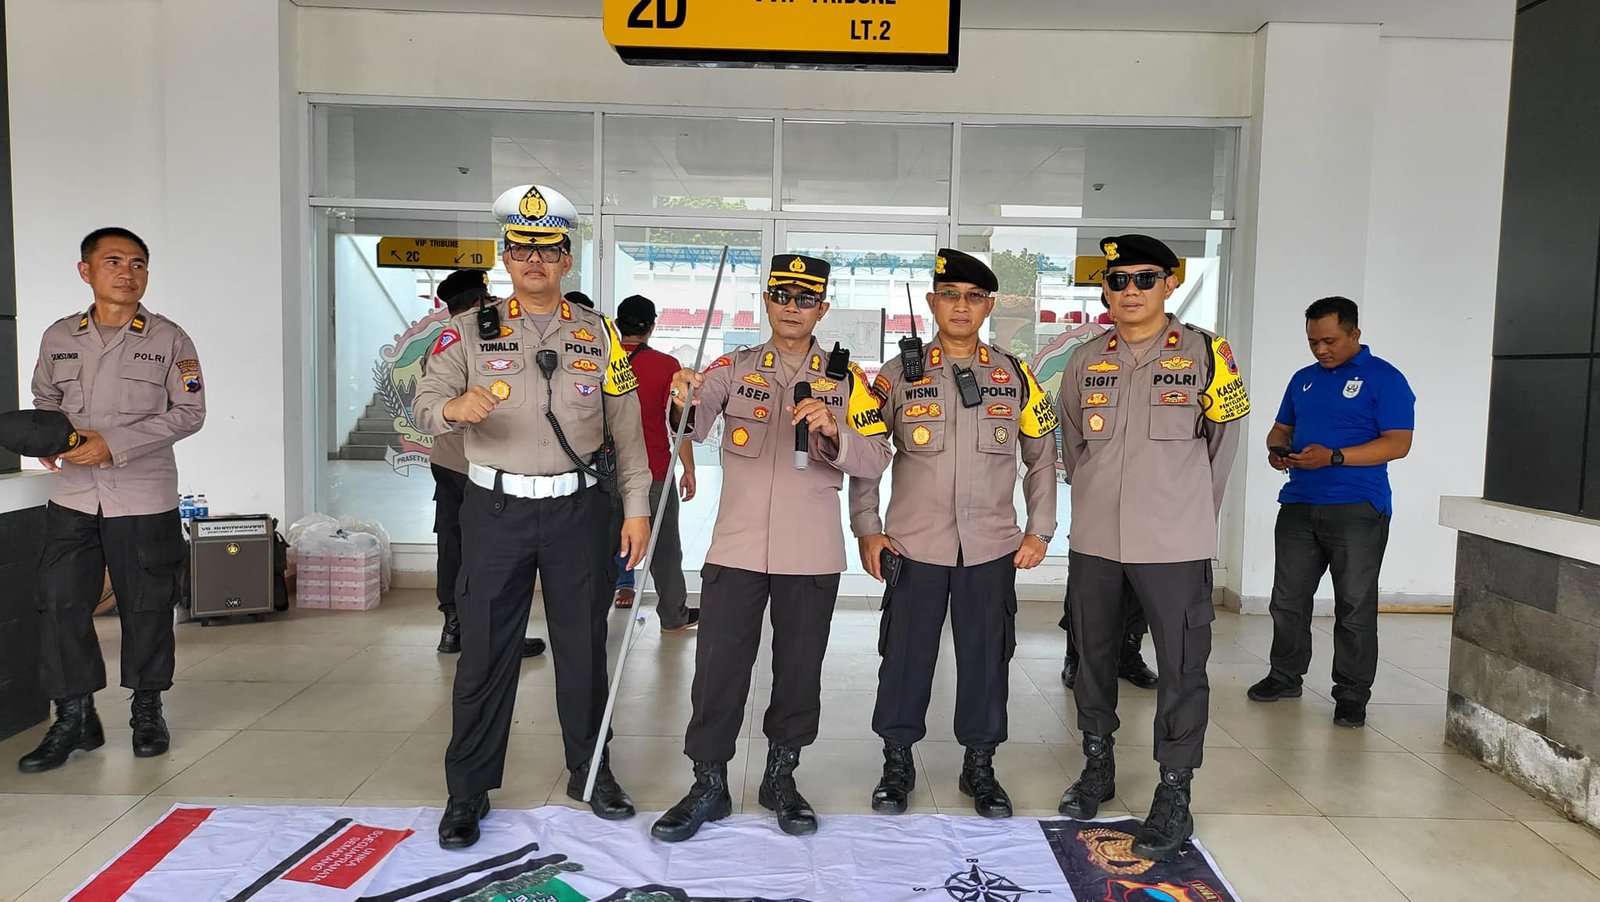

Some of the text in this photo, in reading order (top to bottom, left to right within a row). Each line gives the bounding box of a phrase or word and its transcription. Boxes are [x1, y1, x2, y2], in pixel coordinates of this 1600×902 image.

[850, 19, 892, 41] LT.2
[415, 239, 459, 248] VIP TRIBUNE
[406, 251, 420, 262] 2C
[470, 253, 483, 264] 1D
[479, 342, 519, 352] YUNALDI
[564, 343, 602, 357] POLRI
[133, 352, 166, 364] POLRI
[1084, 376, 1119, 388] SIGIT
[1153, 373, 1197, 386] POLRI
[737, 384, 770, 402] ASEP
[905, 387, 938, 400] WISNU
[981, 386, 1017, 398] POLRI
[397, 454, 429, 465] PRASETYA
[310, 836, 361, 871] SEMARANG
[345, 847, 376, 867] UNIKA
